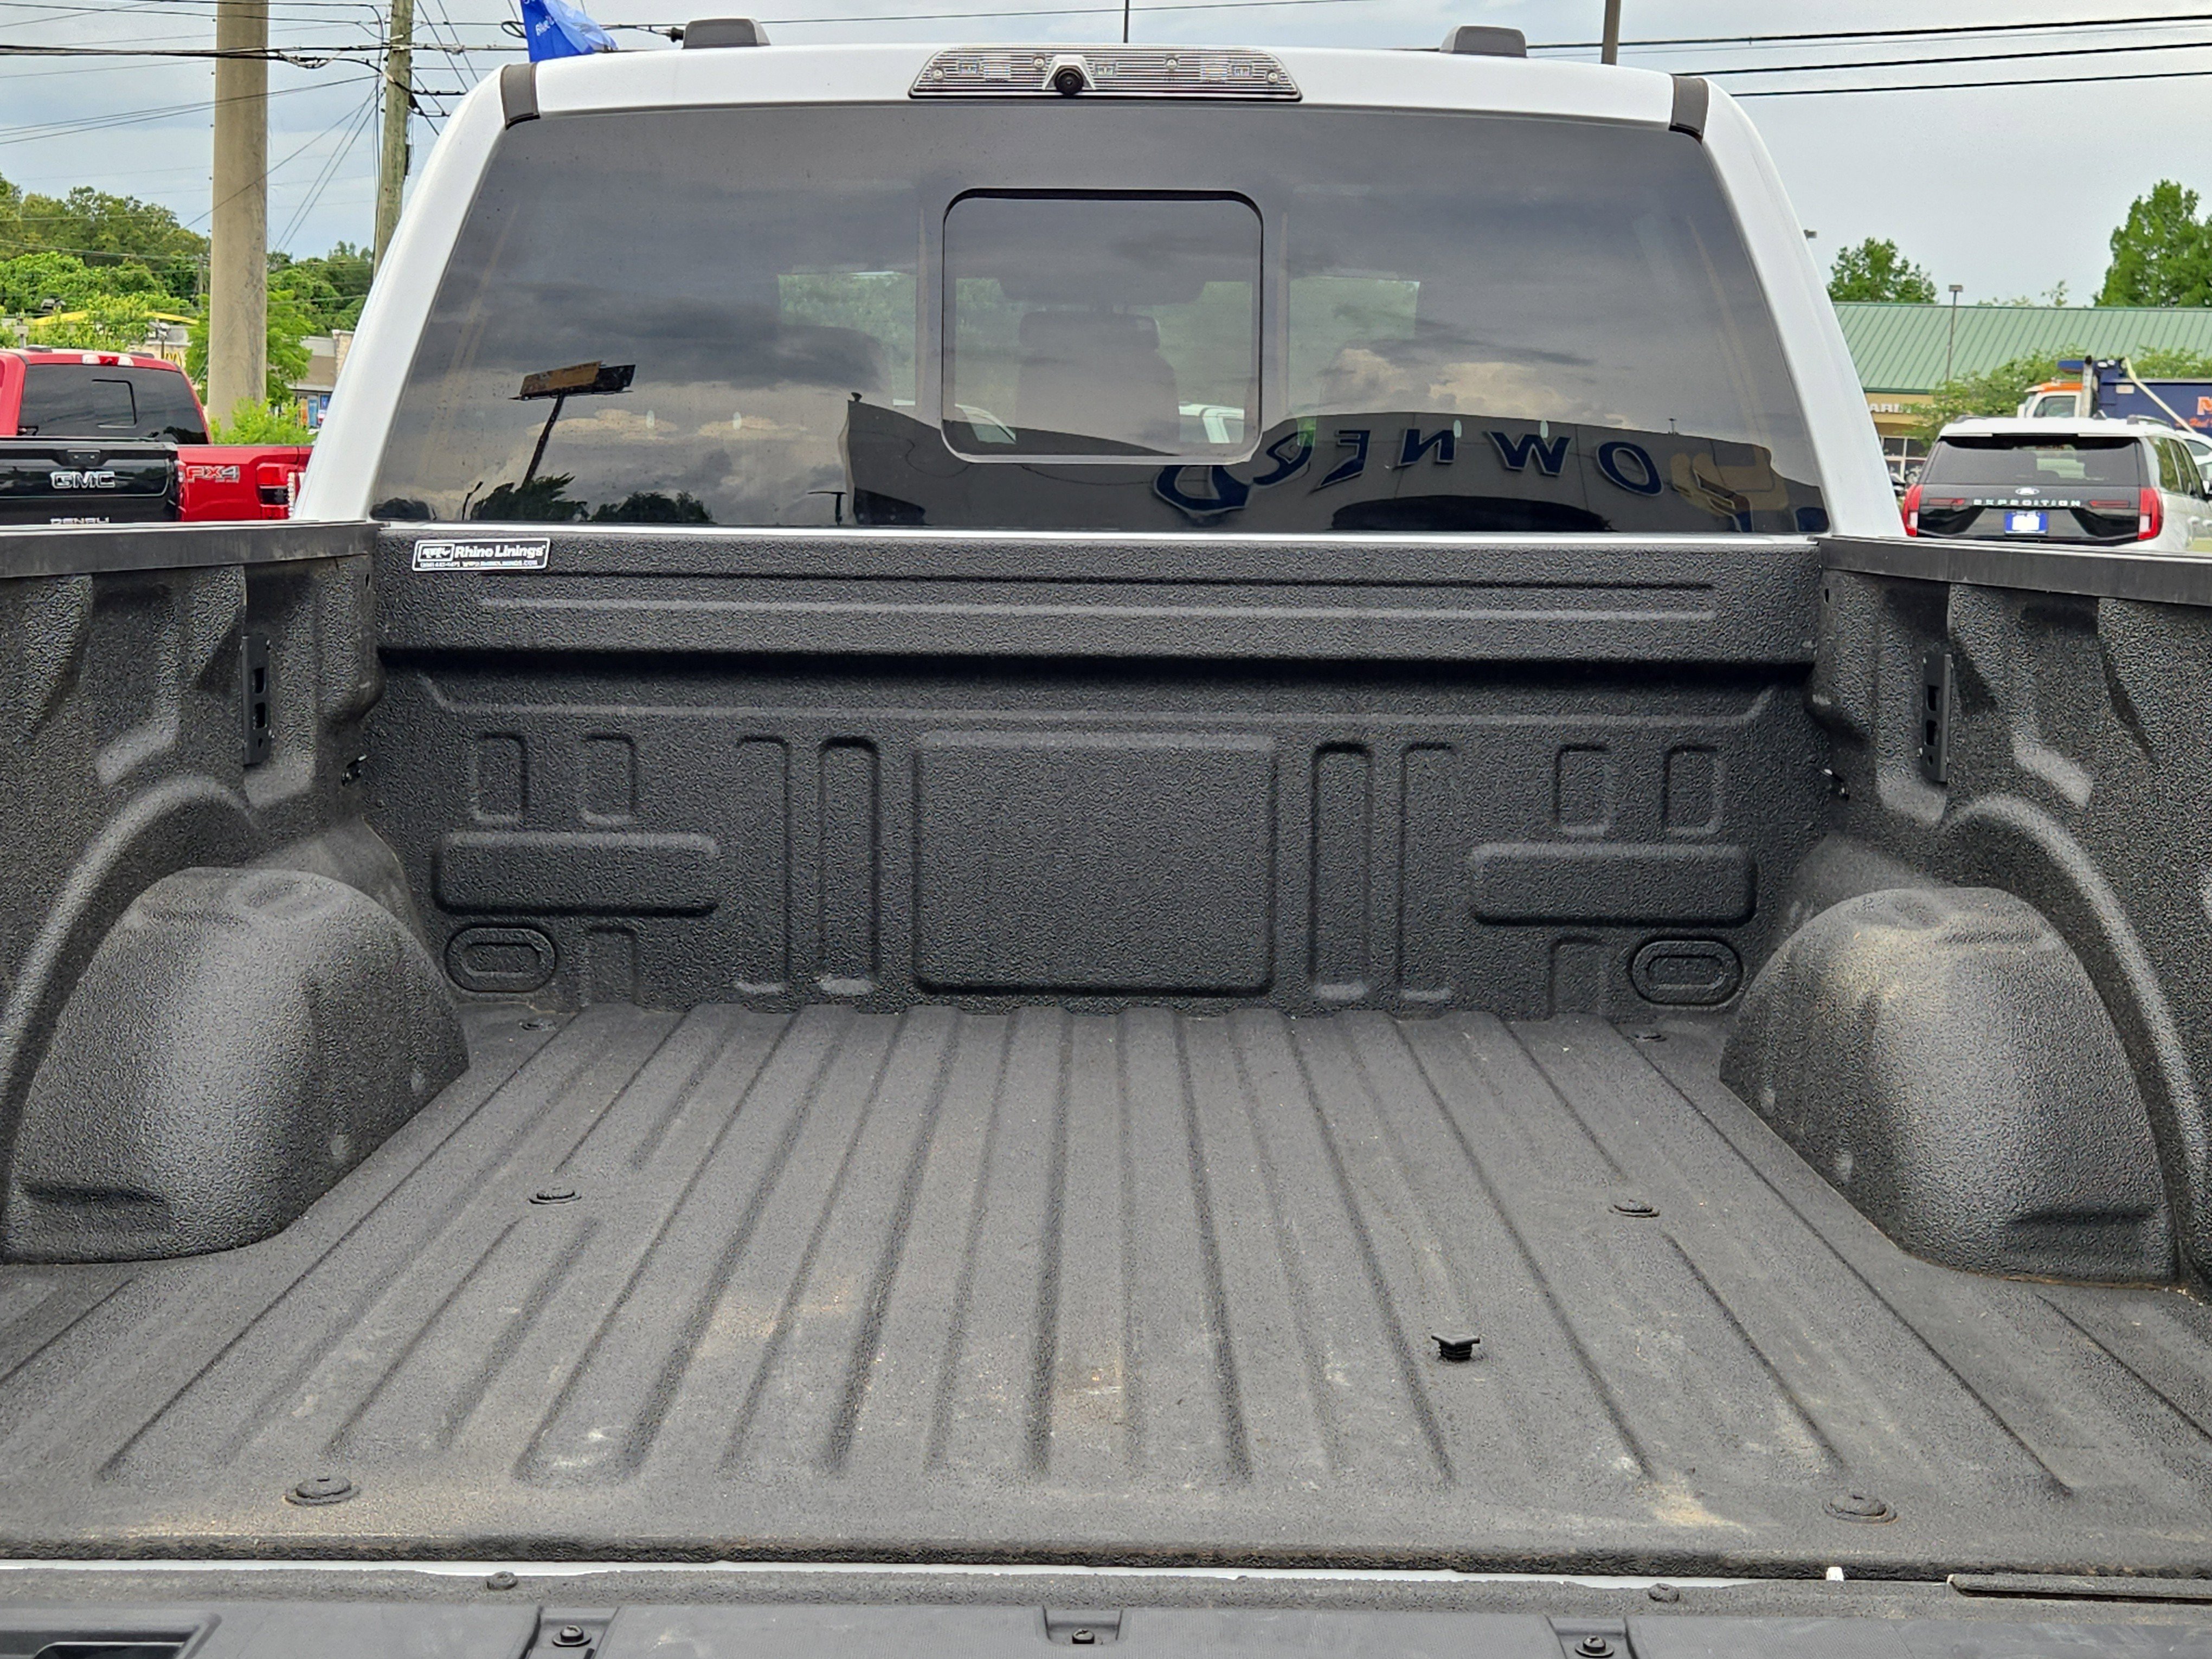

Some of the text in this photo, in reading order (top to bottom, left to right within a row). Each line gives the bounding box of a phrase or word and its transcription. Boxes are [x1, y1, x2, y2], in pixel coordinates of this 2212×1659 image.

[50, 471, 115, 490] GMC
[186, 465, 240, 484] FX4
[1973, 499, 2081, 507] EXPEDITION
[454, 544, 544, 559] Rhino Linings
